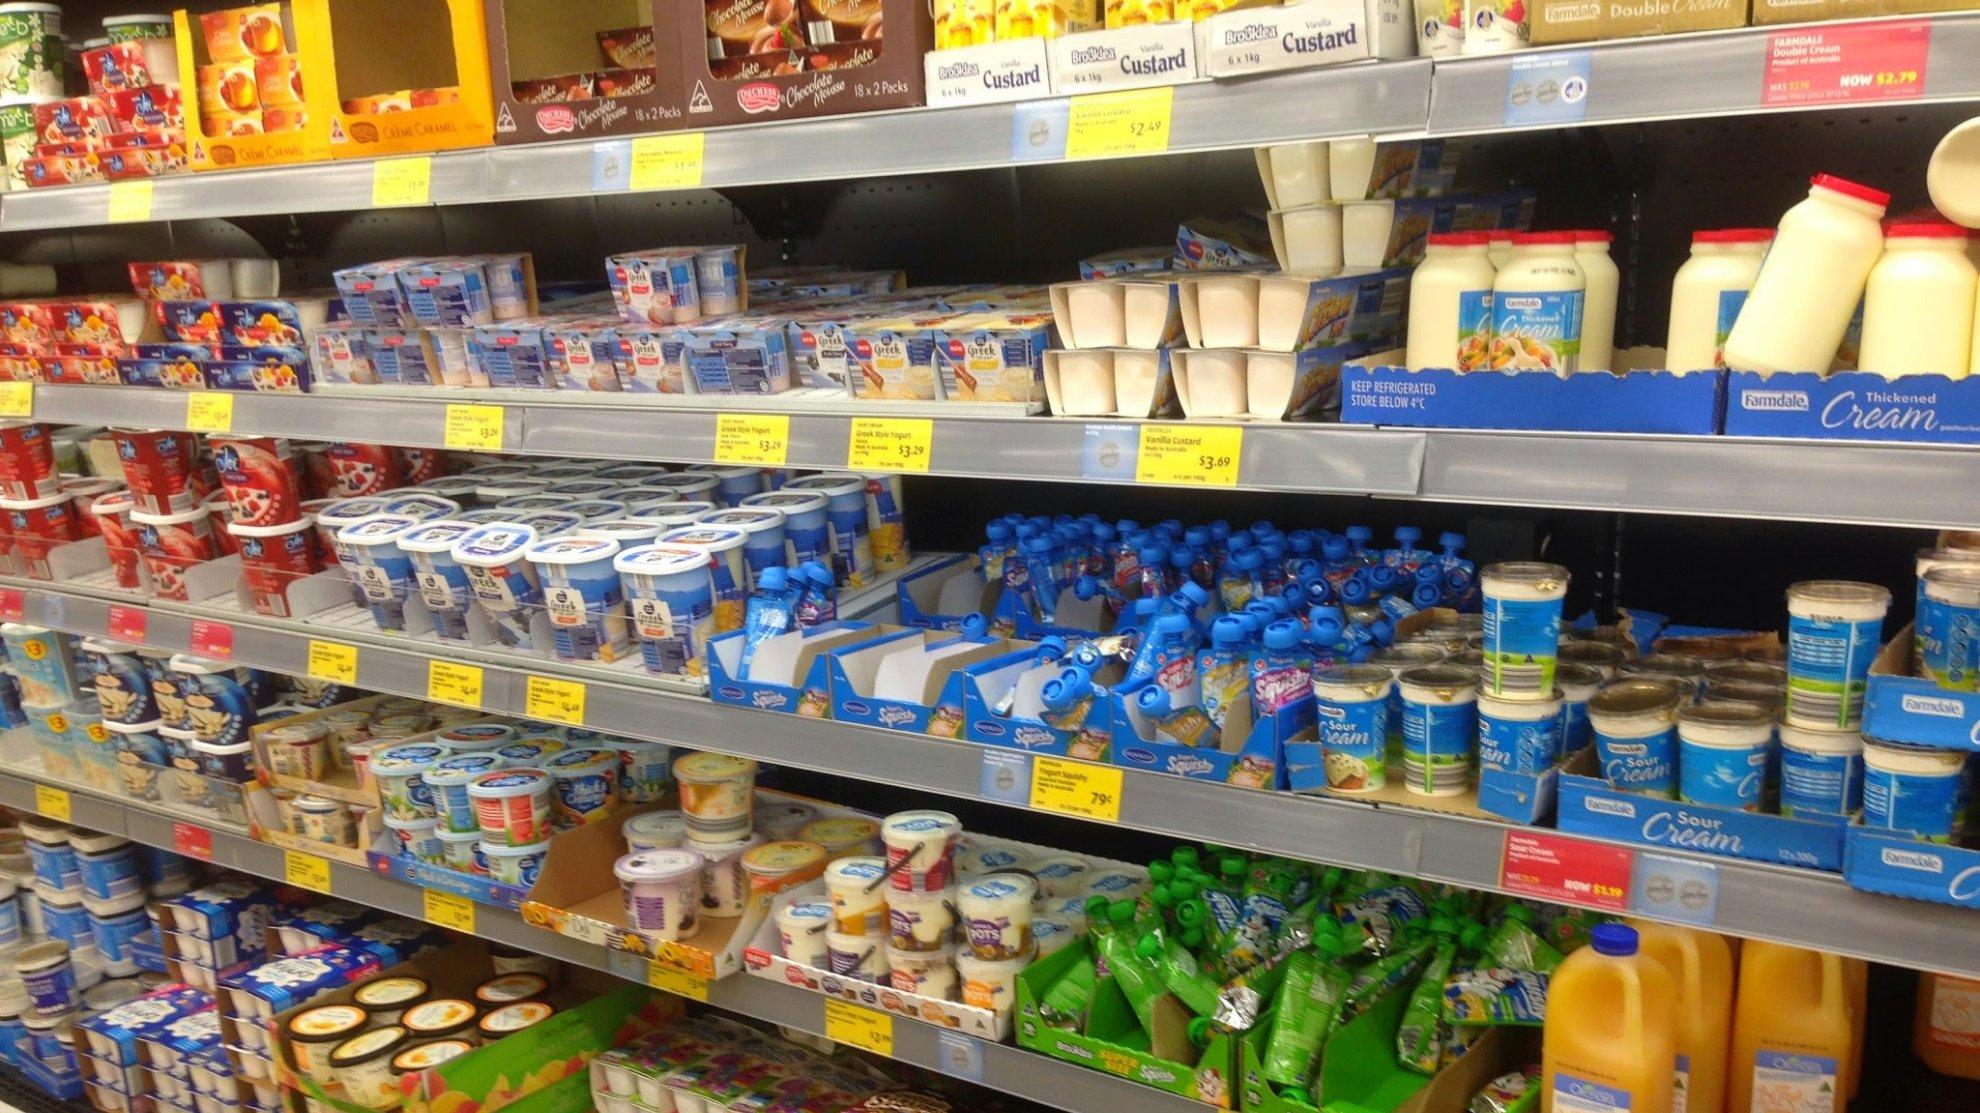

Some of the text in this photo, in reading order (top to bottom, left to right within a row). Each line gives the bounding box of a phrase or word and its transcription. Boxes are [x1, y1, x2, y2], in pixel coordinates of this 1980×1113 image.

[1610, 0, 1669, 18] Double
[1305, 19, 1332, 29] Vanilla
[1282, 23, 1357, 53] Custard
[1141, 43, 1163, 53] Vanilla
[1773, 45, 1840, 57] Double Cream
[1120, 49, 1186, 75] Custard
[1245, 51, 1260, 65] 1kg
[983, 65, 1041, 89] Custard
[1089, 72, 1102, 85] 1kg
[1840, 71, 1917, 88] NOW $2.79
[786, 73, 833, 109] Chocolate
[814, 80, 846, 107] Mousse
[855, 84, 864, 97] 18
[873, 82, 880, 96] 2
[882, 80, 909, 95] Packs
[578, 99, 616, 130] Chocolate
[602, 106, 628, 129] Mousse
[635, 110, 643, 121] 18
[659, 107, 681, 119] Packs
[1131, 120, 1162, 136] $2.49
[1500, 315, 1559, 338] Cream
[818, 336, 844, 348] Greek
[874, 344, 900, 356] Greek
[968, 345, 996, 356] Greek
[1351, 380, 1436, 395] KEEP REFRIGERATED
[1351, 395, 1377, 407] STORE
[1379, 396, 1409, 408] BELOW
[1745, 395, 1806, 408] Farmdale
[1866, 391, 1937, 404] Thickened
[1821, 391, 1939, 431] Cream
[759, 440, 781, 452] $3.29
[1146, 436, 1201, 446] Vanilla Custard
[900, 445, 924, 458] $3.29
[1200, 456, 1230, 470] $3.69
[1906, 699, 1961, 715] Farmdale
[1329, 720, 1357, 731] Sour
[1626, 757, 1660, 768] Sour
[1607, 759, 1671, 784] Cream
[1677, 811, 1723, 830] Sour
[1643, 812, 1744, 852] Cream
[1564, 879, 1591, 892] NOW
[972, 930, 1000, 940] POTS
